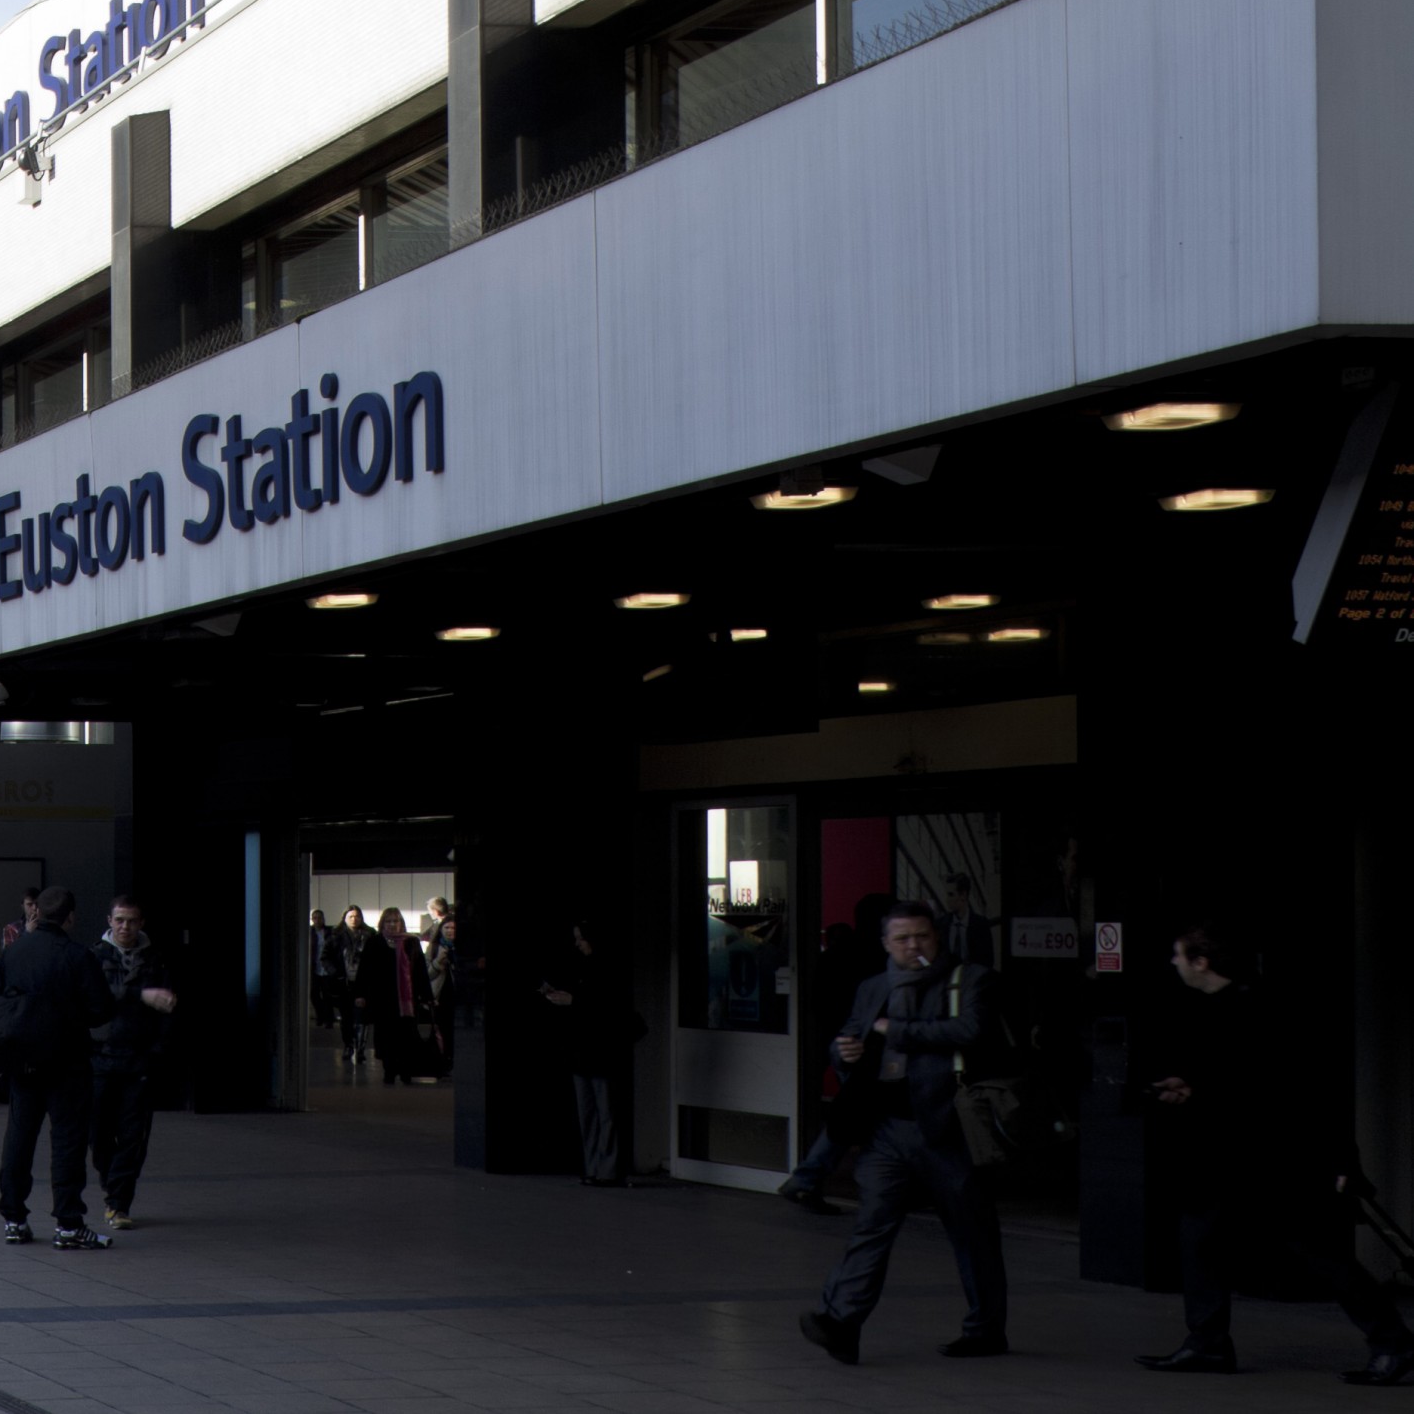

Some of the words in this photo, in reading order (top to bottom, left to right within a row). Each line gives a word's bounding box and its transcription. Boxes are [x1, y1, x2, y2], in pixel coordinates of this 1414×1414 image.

[182, 371, 445, 544] Station
[1380, 572, 1412, 584] Travel
[1372, 590, 1411, 601] Watford
[1338, 607, 1372, 621] Page
[1375, 607, 1386, 619] 2
[1389, 608, 1407, 619] of
[1395, 628, 1414, 642] De
[1018, 932, 1028, 948] 4
[1044, 932, 1075, 949] £90
